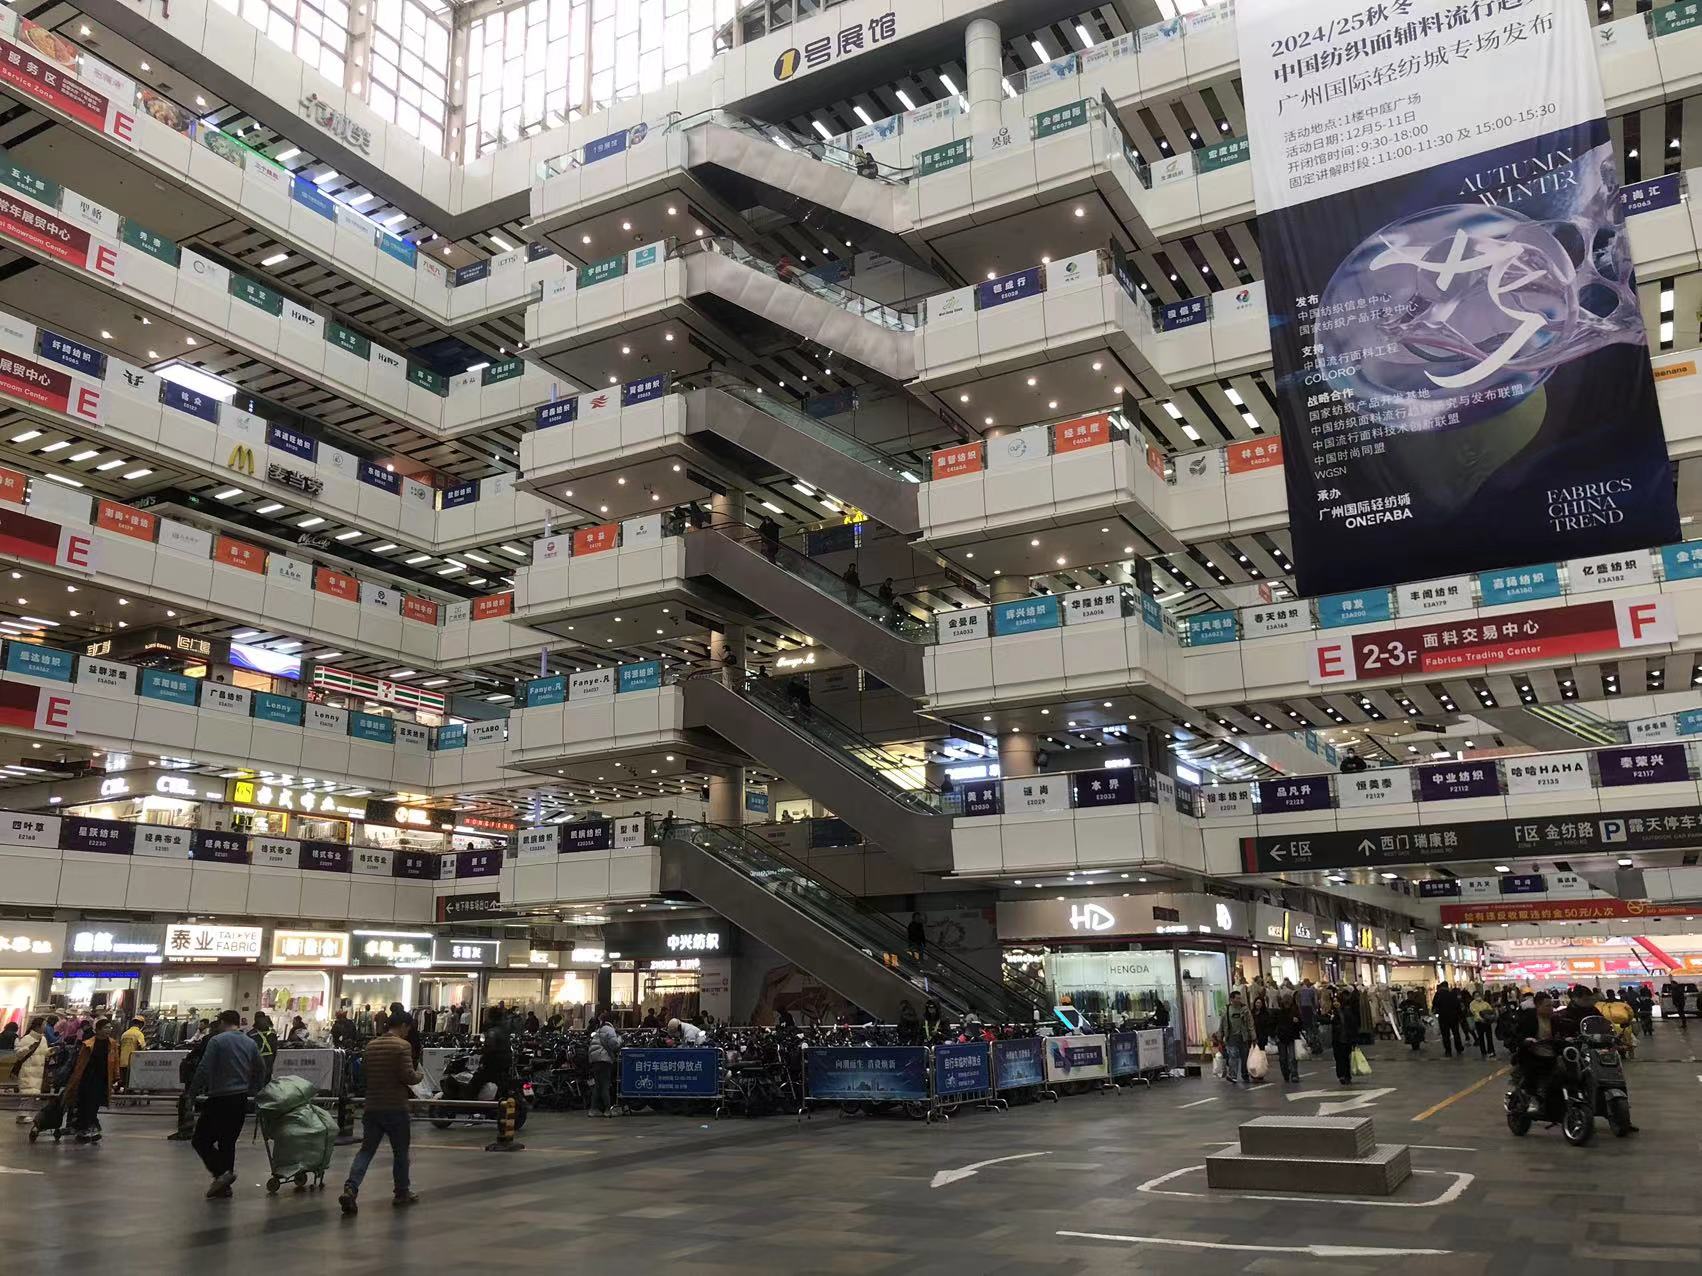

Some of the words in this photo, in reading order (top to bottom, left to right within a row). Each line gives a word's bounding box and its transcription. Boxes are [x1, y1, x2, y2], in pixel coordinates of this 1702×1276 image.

[1275, 0, 1532, 83] 中国纺织面辅料流行
[1279, 13, 1552, 116] 广州国际轻纺城专场发布
[2, 67, 31, 86] Service
[34, 84, 54, 99] Zone
[113, 111, 135, 142] E
[1475, 102, 1556, 135] 15:00-15:30
[1459, 148, 1574, 195] AUTUMN
[1478, 171, 1579, 208] WINTER
[7, 223, 44, 245] Showroom
[45, 241, 68, 256] Center
[96, 245, 117, 276] E
[1296, 294, 1318, 308] 发布
[1298, 293, 1391, 321] 中国纺织信息中心
[1299, 301, 1418, 336] 国家纺织产品开发中心
[1302, 344, 1324, 357] 支持
[1304, 342, 1400, 371] 中国流行面料工程
[24, 388, 48, 401] Center
[77, 387, 99, 418] E
[1307, 388, 1354, 407] 战略合作
[1309, 388, 1431, 422] 国家纺织产品开发基地
[1312, 412, 1460, 451] 中国流行面料技术创新联盟
[1314, 442, 1386, 466] 中国时尚同盟
[268, 462, 324, 497] 麦当劳
[1314, 466, 1347, 480] WGSN
[1317, 488, 1341, 501] 承办
[1547, 478, 1632, 504] FABRICS
[1319, 493, 1411, 520] 广州国际轻纺城
[1548, 497, 1617, 519] CHINA
[1345, 508, 1413, 529] ONEFABA
[1549, 510, 1624, 532] TREND
[67, 536, 91, 567] E
[1583, 559, 1638, 576] 亿盛纺织
[1254, 609, 1299, 623] 春天纺织
[1629, 603, 1656, 639] F
[1423, 619, 1539, 648] 面料交易中心
[1317, 645, 1344, 677] E
[1362, 642, 1417, 669] 2-3F
[1426, 655, 1462, 666] Fabrics
[1466, 648, 1504, 663] Trading
[1507, 645, 1541, 656] Center
[46, 696, 70, 727] E
[1433, 770, 1484, 785] 中业纺织
[1511, 762, 1584, 777] 哈哈HAHA
[1277, 785, 1311, 797] 品凡升
[12, 821, 45, 832] 四叶草
[1515, 825, 1540, 842] F区
[1545, 823, 1593, 840] 金纺路
[1604, 823, 1621, 841] P
[145, 833, 181, 845] 经典布业
[205, 839, 239, 851] 经典布业
[1291, 841, 1313, 856] E区
[1380, 835, 1410, 850] 西门
[1414, 832, 1459, 848] 瑞康路
[1070, 903, 1115, 931] HD
[171, 929, 213, 951] 泰业
[216, 942, 257, 953] FABRIC
[668, 933, 720, 951] 中兴纺织
[1110, 965, 1150, 975] HENGDA
[635, 1060, 703, 1072] 自行车临时停放点
